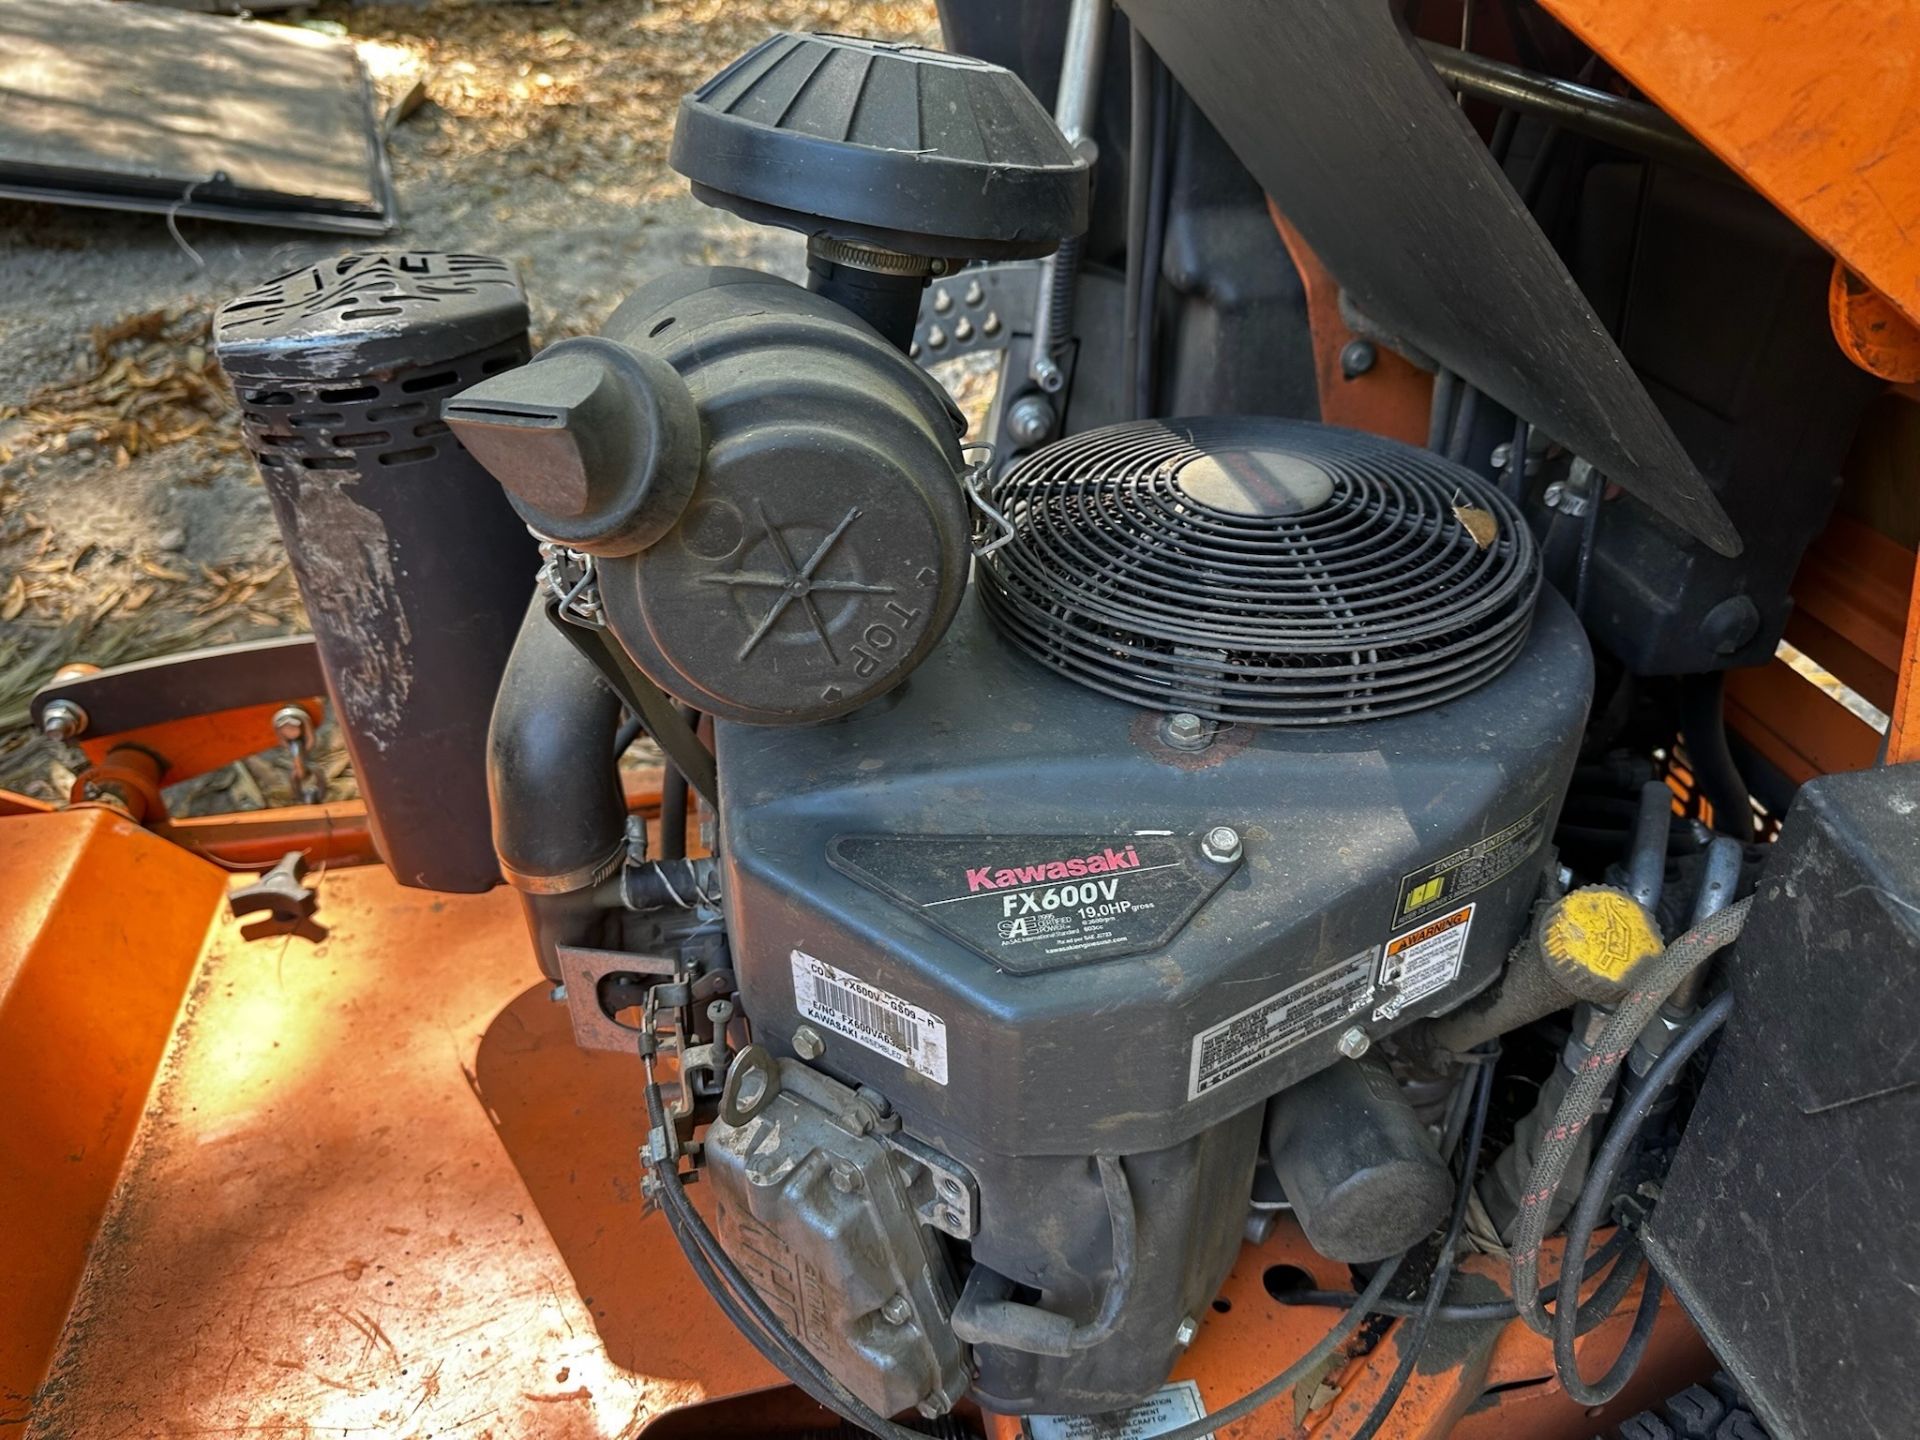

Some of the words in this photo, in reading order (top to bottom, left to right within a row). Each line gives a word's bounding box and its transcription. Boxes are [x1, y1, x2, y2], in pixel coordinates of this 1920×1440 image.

[849, 601, 921, 679] TOP
[1434, 849, 1471, 873] ENGINE
[1473, 814, 1535, 853] AINTENANCE
[966, 845, 1141, 892] Kawasaki
[1003, 878, 1119, 917] FX600V
[1077, 900, 1131, 919] 19.0HP
[1131, 902, 1155, 913] gross
[997, 915, 1039, 940] SAE
[1408, 914, 1462, 942] WARNING
[812, 1000, 836, 1018] E/NO
[807, 1008, 859, 1039] KAWASAKI
[860, 1034, 902, 1061] ASSEMBLED
